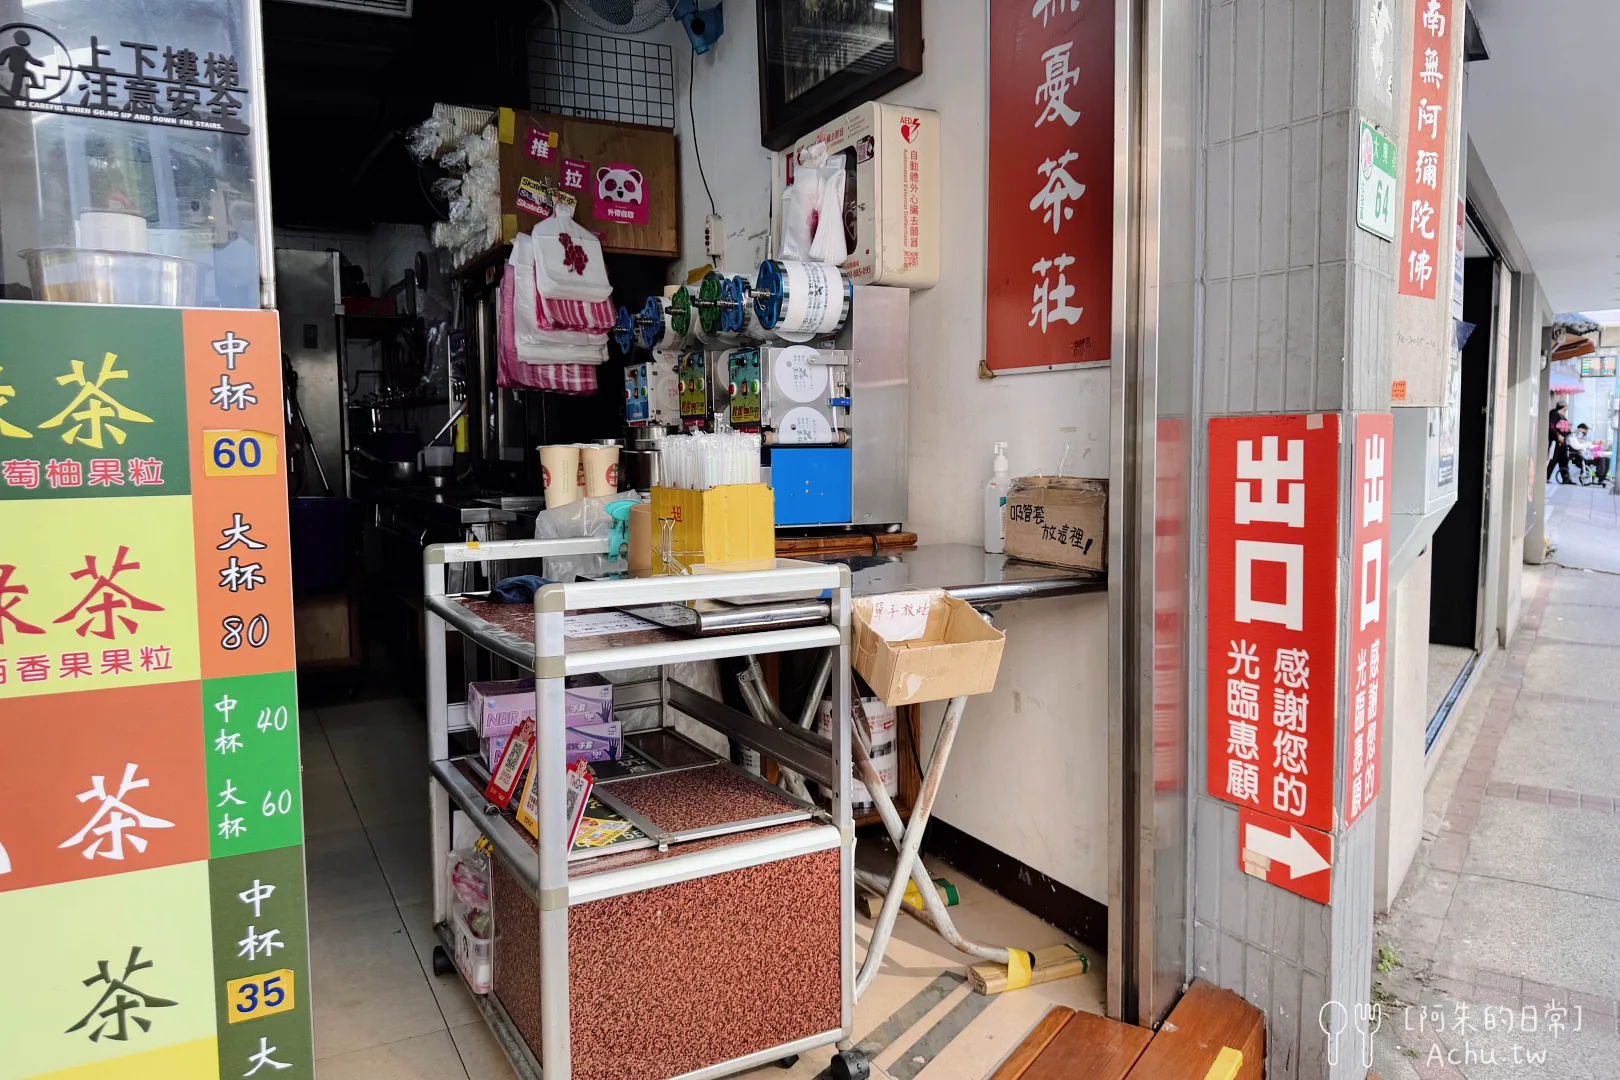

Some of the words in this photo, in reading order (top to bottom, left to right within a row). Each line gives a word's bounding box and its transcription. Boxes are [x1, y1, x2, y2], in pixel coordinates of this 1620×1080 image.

[78, 36, 240, 87] 上下樓梯
[28, 101, 65, 111] CAREFUL
[66, 105, 91, 114] WHEN
[92, 108, 119, 118] GONG
[134, 113, 151, 121] AND
[152, 116, 177, 124] DOWN
[78, 70, 242, 119] 注意安全
[900, 116, 912, 125] AED
[531, 137, 549, 158] 推
[1407, 1, 1446, 291] 南無阿彌陀佛
[565, 169, 583, 189] 拉
[1374, 179, 1389, 222] 64
[210, 331, 258, 411] 中杯
[0, 352, 155, 449] 茶
[2, 457, 165, 489] 萄柚果粒
[212, 437, 262, 469] 60
[1009, 503, 1045, 525] 吸管套
[1234, 435, 1306, 632] 出口
[1359, 433, 1385, 632] 出口
[216, 513, 268, 592] 大杯
[220, 613, 270, 650] 80
[0, 644, 174, 686] 香果果粒
[214, 694, 244, 755] 中杯
[256, 705, 288, 733] 40
[486, 710, 519, 729] NBR
[1225, 638, 1260, 805] 光臨惠顧
[1272, 647, 1310, 817] 感謝您的
[1350, 648, 1367, 818] 光臨惠顧
[1364, 637, 1380, 804] 感謝您的
[216, 779, 248, 840] 大杯
[261, 789, 292, 817] 60
[238, 879, 285, 961] 中杯
[63, 945, 181, 1043] 茶
[236, 975, 286, 1014] 35
